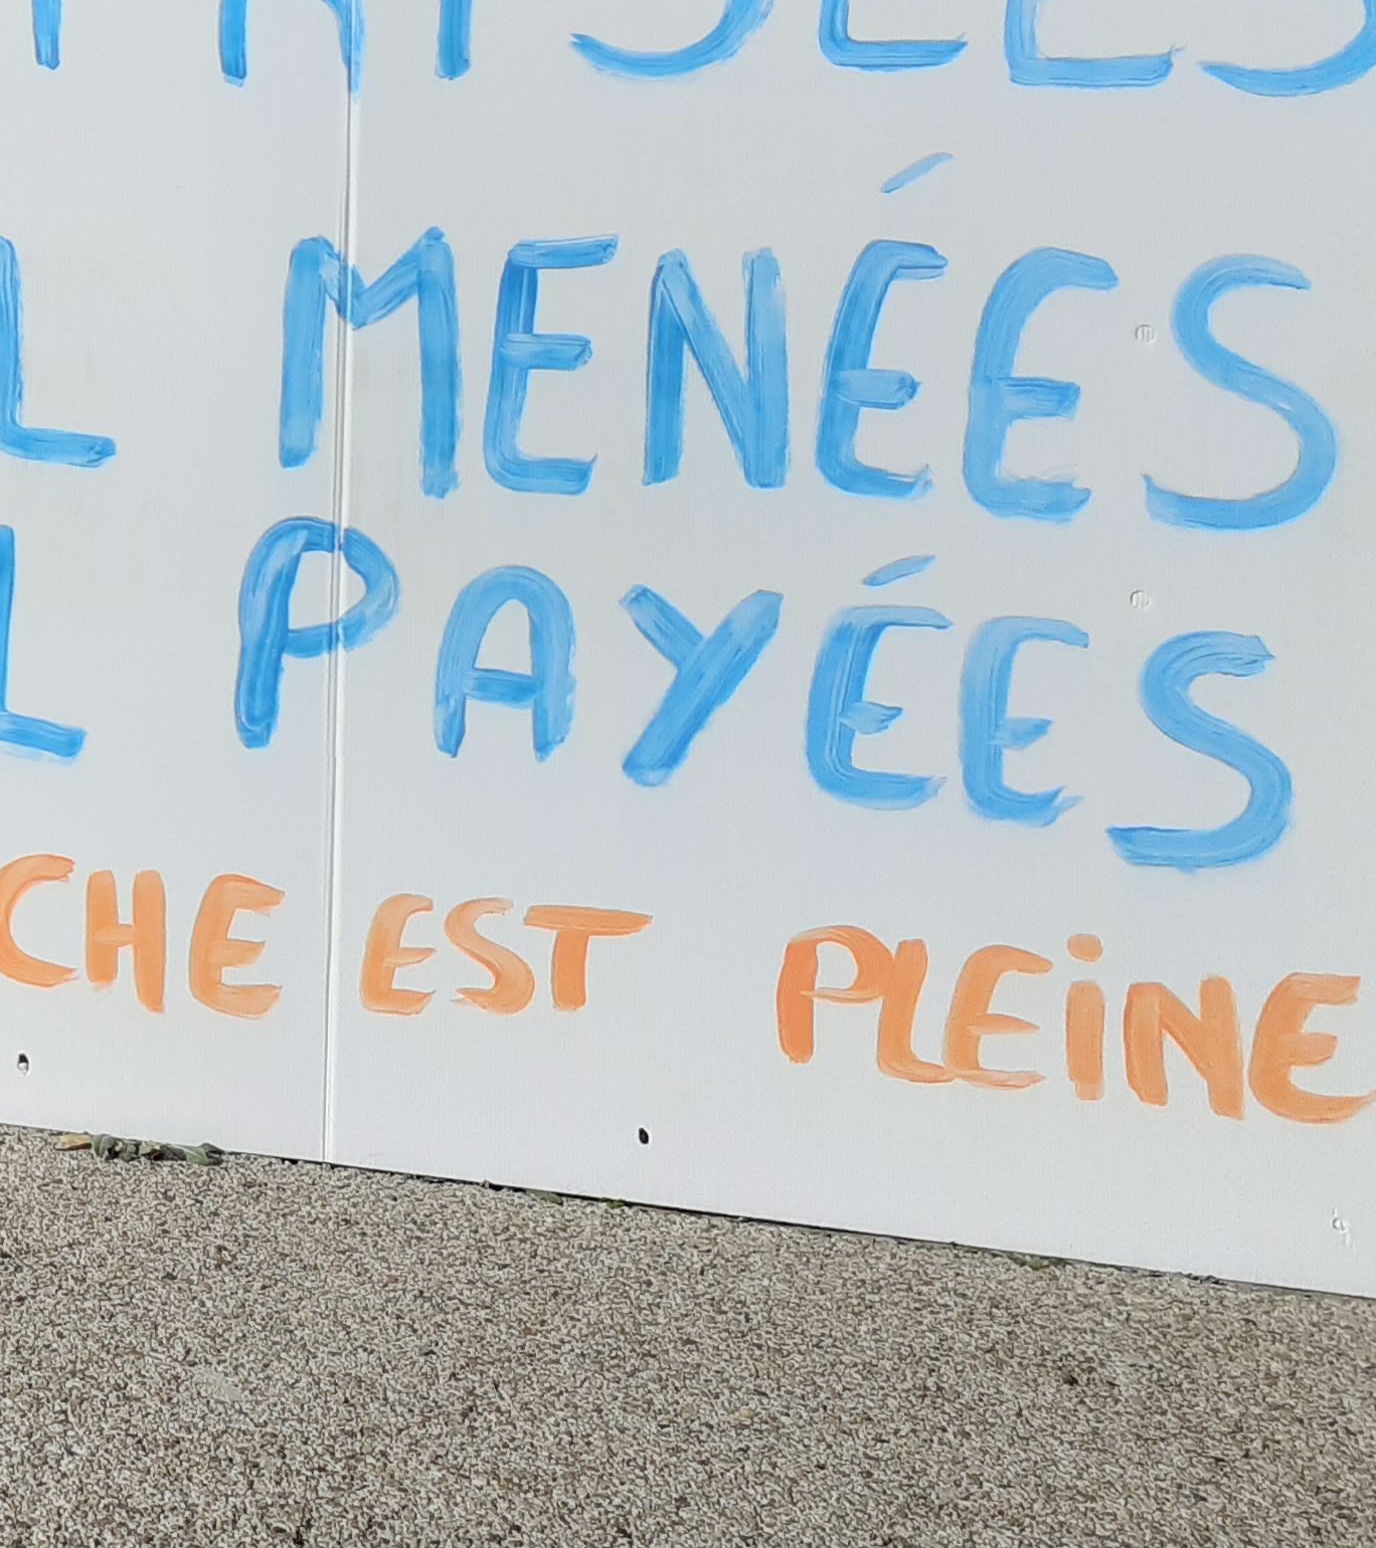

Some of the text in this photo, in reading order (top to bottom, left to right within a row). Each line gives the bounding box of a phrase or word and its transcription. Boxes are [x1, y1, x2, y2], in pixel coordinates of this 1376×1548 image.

[278, 151, 1343, 531] MENÉES
[233, 515, 1296, 873] PAYÉES
[359, 892, 653, 1016] EST
